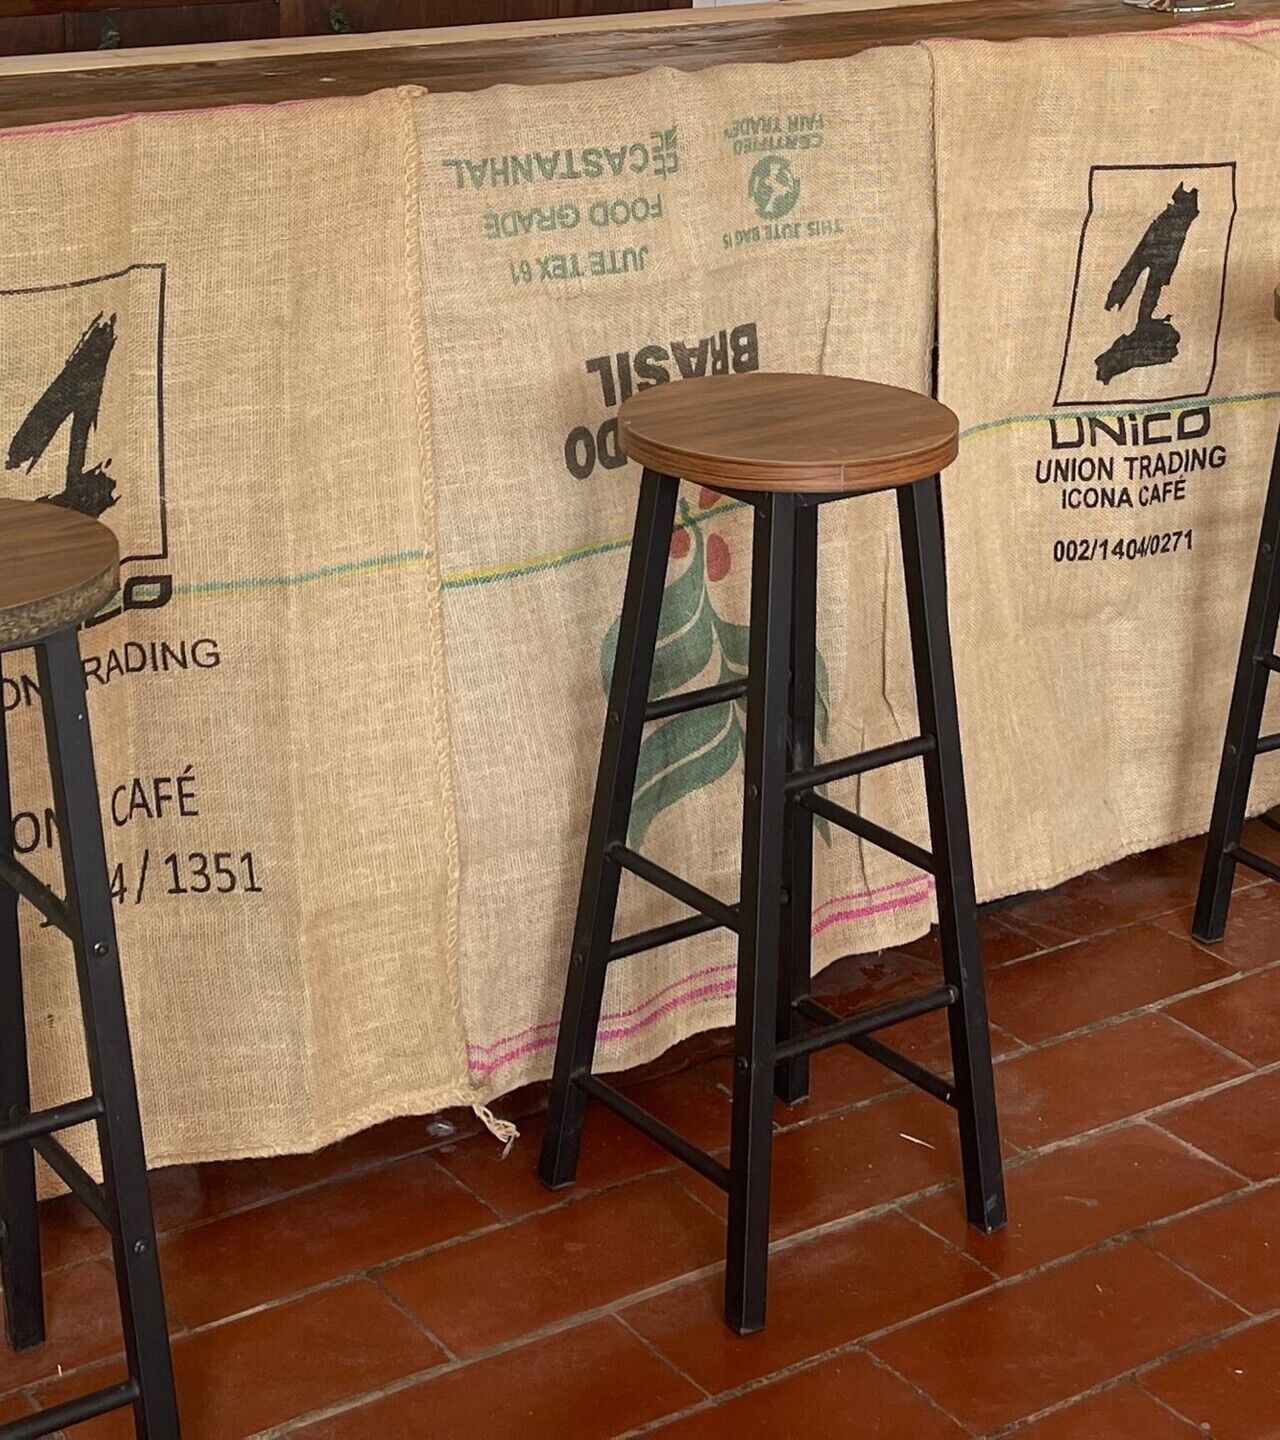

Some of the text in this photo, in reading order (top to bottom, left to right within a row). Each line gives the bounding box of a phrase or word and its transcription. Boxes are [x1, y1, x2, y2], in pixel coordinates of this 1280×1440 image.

[441, 143, 650, 191] CASTANHAL
[481, 193, 663, 240] FOOD GRADE
[536, 252, 585, 281] TEX
[588, 245, 649, 277] JUTE
[586, 323, 760, 407] BRASIL
[564, 418, 628, 480] DO
[1035, 445, 1227, 484] UNION TRADING
[1062, 475, 1187, 510] ICONA CAFÉ
[83, 638, 221, 688] RADING
[111, 765, 199, 827] CAFÉ
